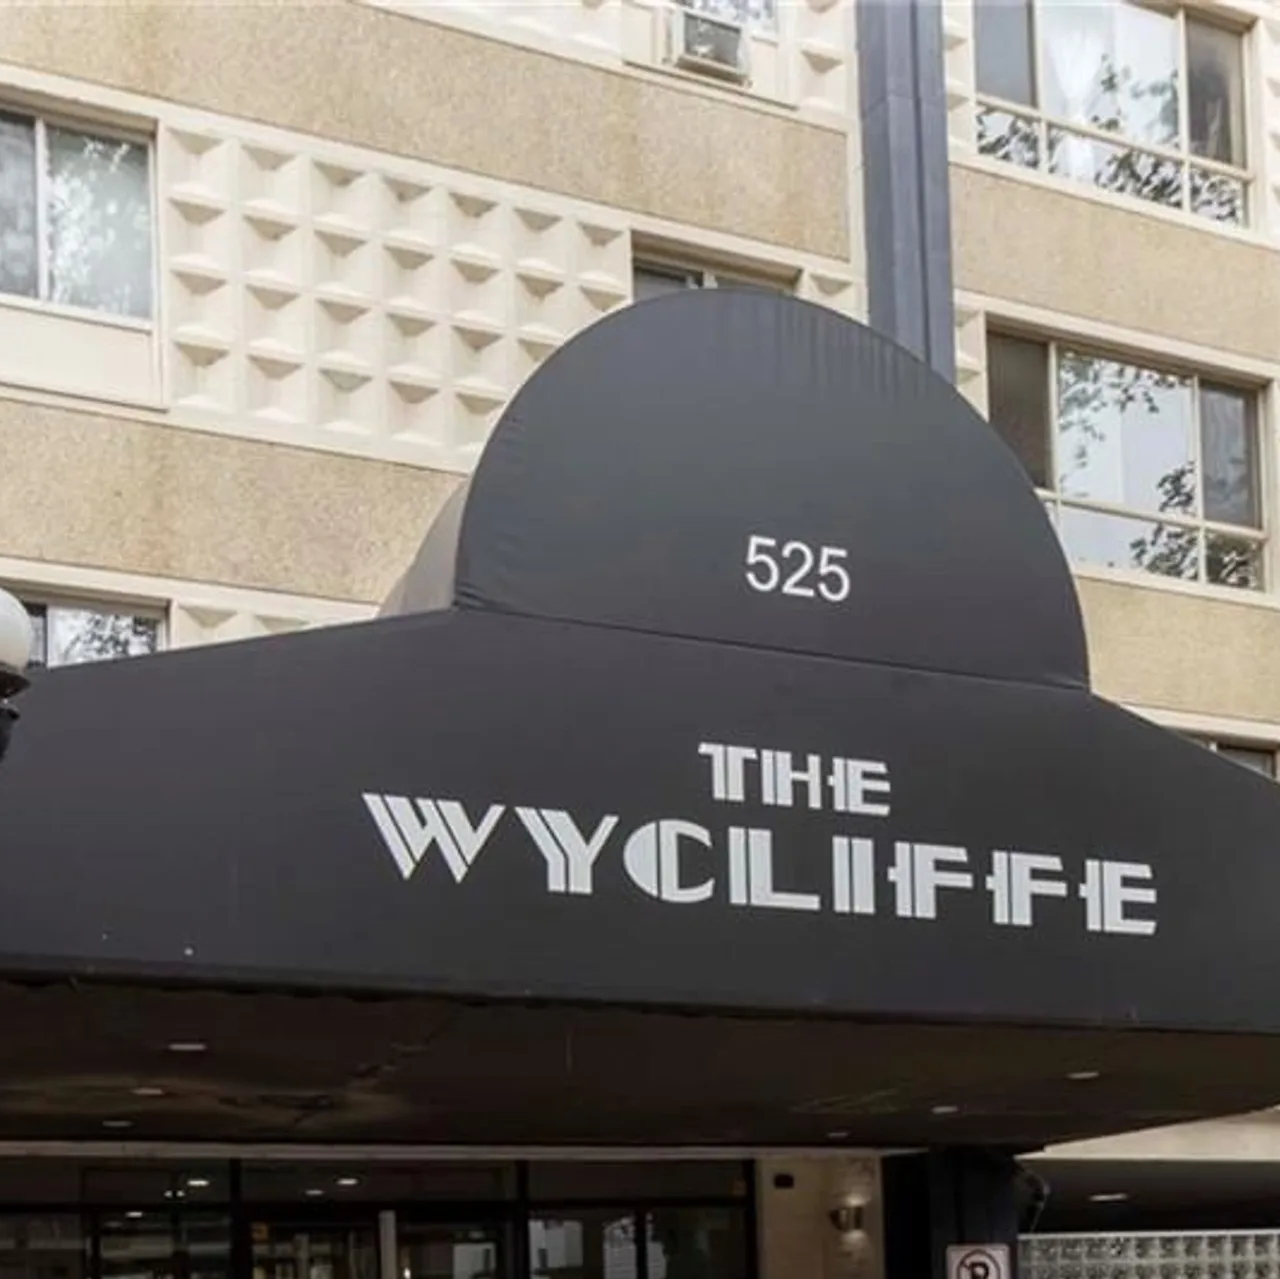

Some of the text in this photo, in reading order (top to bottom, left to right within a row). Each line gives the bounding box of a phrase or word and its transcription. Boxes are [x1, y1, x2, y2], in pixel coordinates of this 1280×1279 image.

[745, 536, 851, 601] 525
[698, 742, 891, 817] THE
[362, 792, 1158, 936] WYCLIFFE
